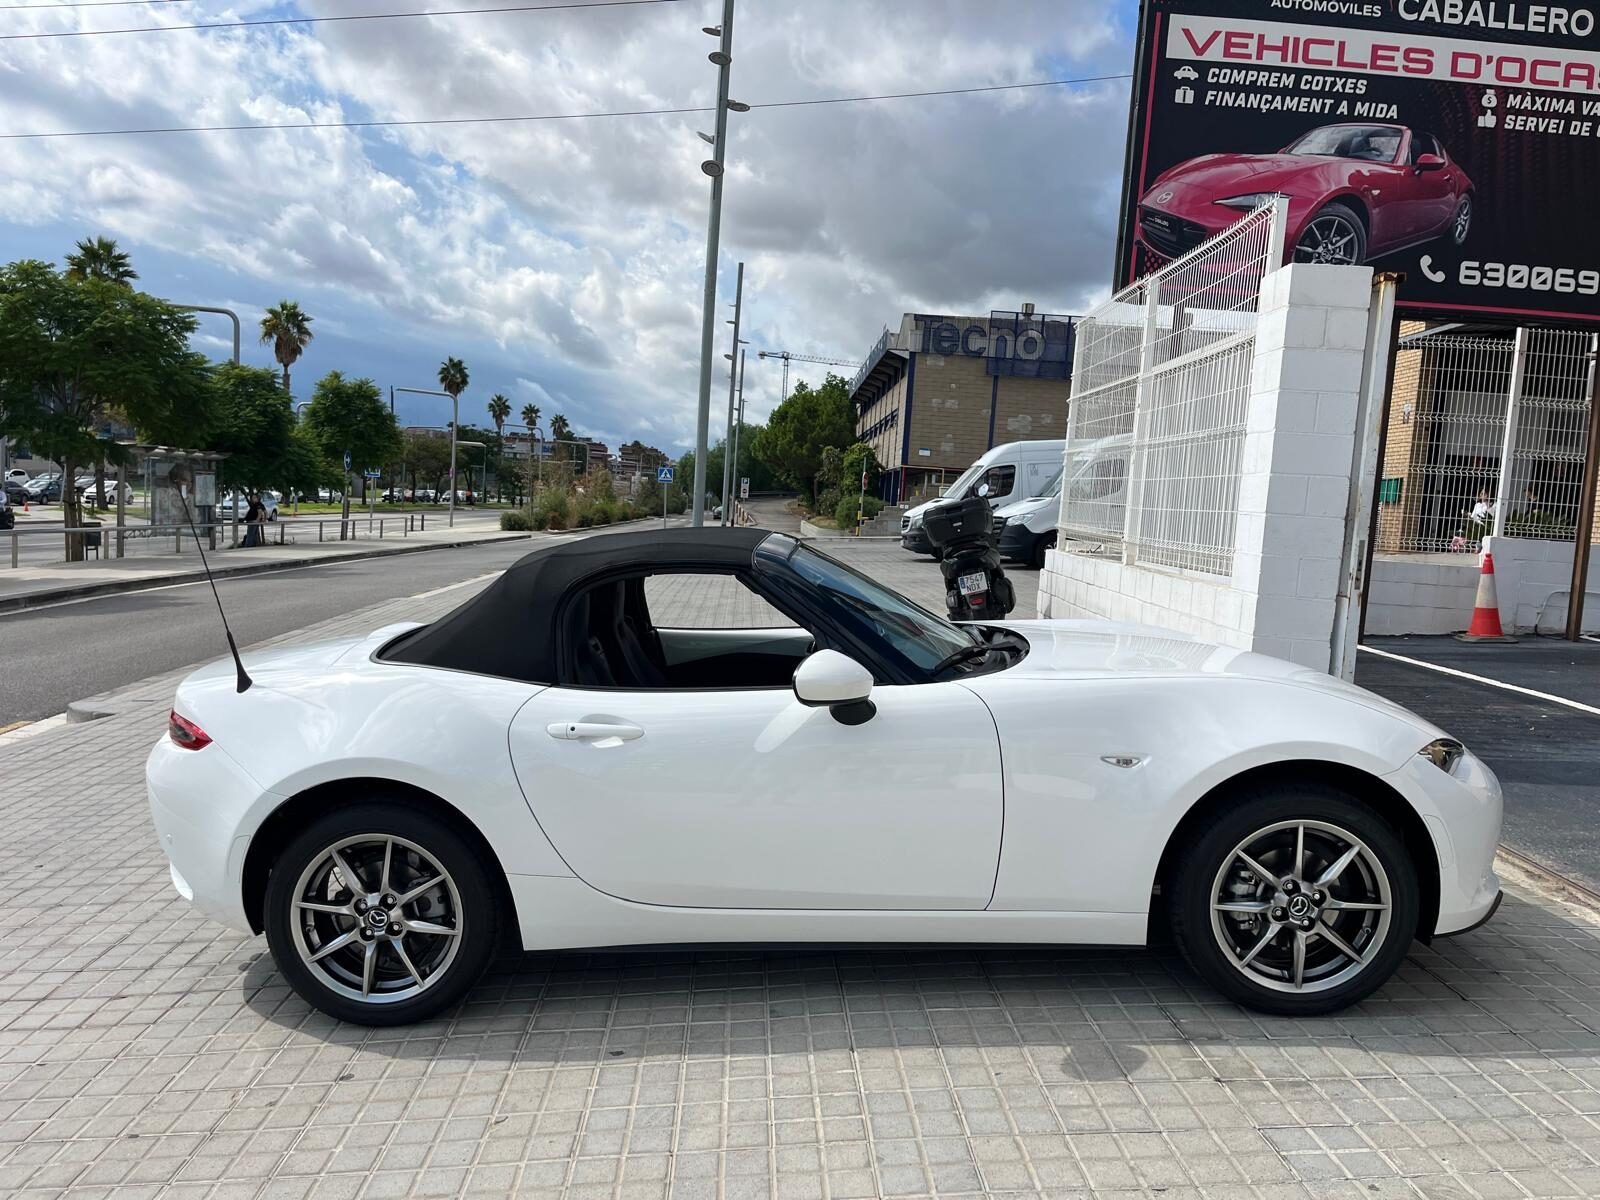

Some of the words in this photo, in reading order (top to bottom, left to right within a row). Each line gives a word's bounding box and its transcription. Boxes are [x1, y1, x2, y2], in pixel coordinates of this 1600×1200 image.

[1270, 0, 1382, 17] AUTOMÓVILES
[1398, 0, 1595, 37] CABALLERO
[1181, 28, 1435, 75] VEHICLES
[1450, 51, 1600, 91] D'OCA
[1207, 68, 1296, 89] COMPREM
[1300, 74, 1368, 95] COTXES
[1204, 90, 1334, 114] FINANÇAMENT
[1336, 100, 1349, 116] A
[1353, 102, 1399, 120] MIDA
[1506, 92, 1576, 115] MÀXIMA
[1504, 115, 1566, 134] SERVEI
[1569, 121, 1593, 137] DE
[1459, 260, 1600, 296] 630069
[914, 313, 1046, 361] Tecno
[965, 573, 984, 584] 7547
